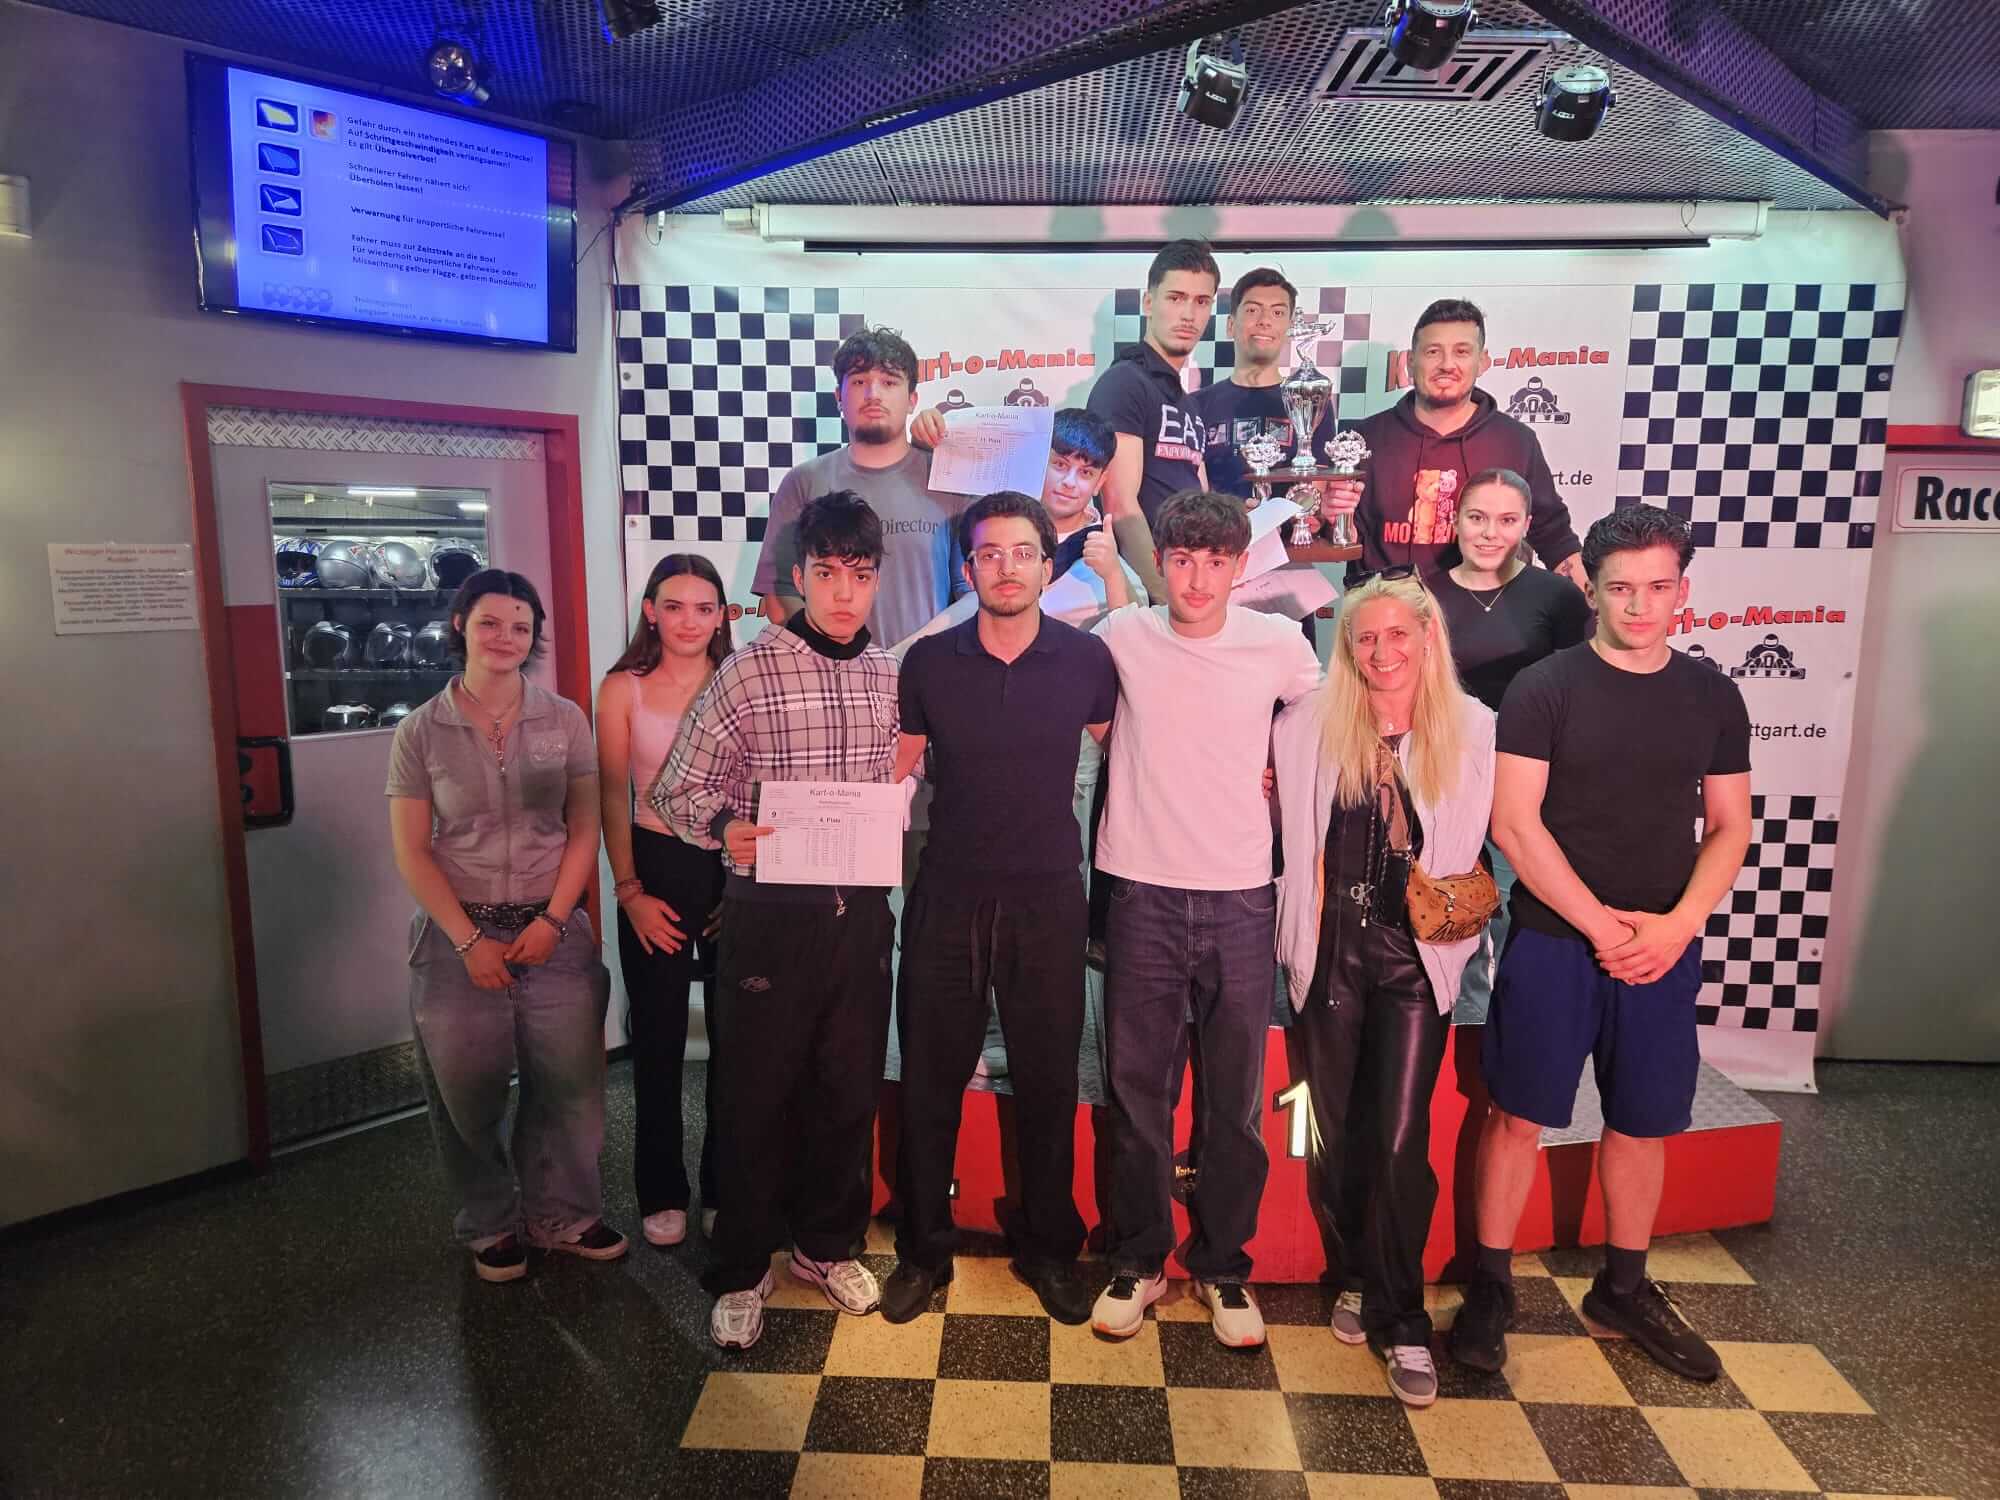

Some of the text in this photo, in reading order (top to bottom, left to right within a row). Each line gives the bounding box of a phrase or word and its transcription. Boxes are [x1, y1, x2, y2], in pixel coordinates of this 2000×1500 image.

[347, 117, 376, 129] Gefahr
[378, 123, 401, 134] durch
[403, 128, 416, 137] ein
[418, 133, 458, 147] stehendes
[477, 145, 489, 153] auf
[348, 128, 363, 137] Auf
[348, 139, 357, 147] Es
[360, 142, 373, 151] gilt
[348, 162, 395, 177] Schnellerer
[397, 172, 422, 183] Fahrer
[350, 172, 424, 194] Überholen lassen!
[350, 205, 401, 222] Verwarnung
[402, 214, 414, 223] für
[416, 217, 464, 232] unsportliche
[351, 234, 378, 245] Fahrer
[380, 239, 401, 248] muss
[417, 244, 453, 257] Zeitstrafe
[455, 251, 465, 259] an
[466, 252, 478, 261] die
[352, 245, 519, 278] Für wiederholt unsportliche Fahrweise oder
[352, 256, 404, 272] Missachtung
[405, 264, 430, 274] gelber
[880, 518, 939, 535] Director
[1666, 605, 1847, 636] rt-o-Mania
[1275, 1080, 1308, 1158] 1
